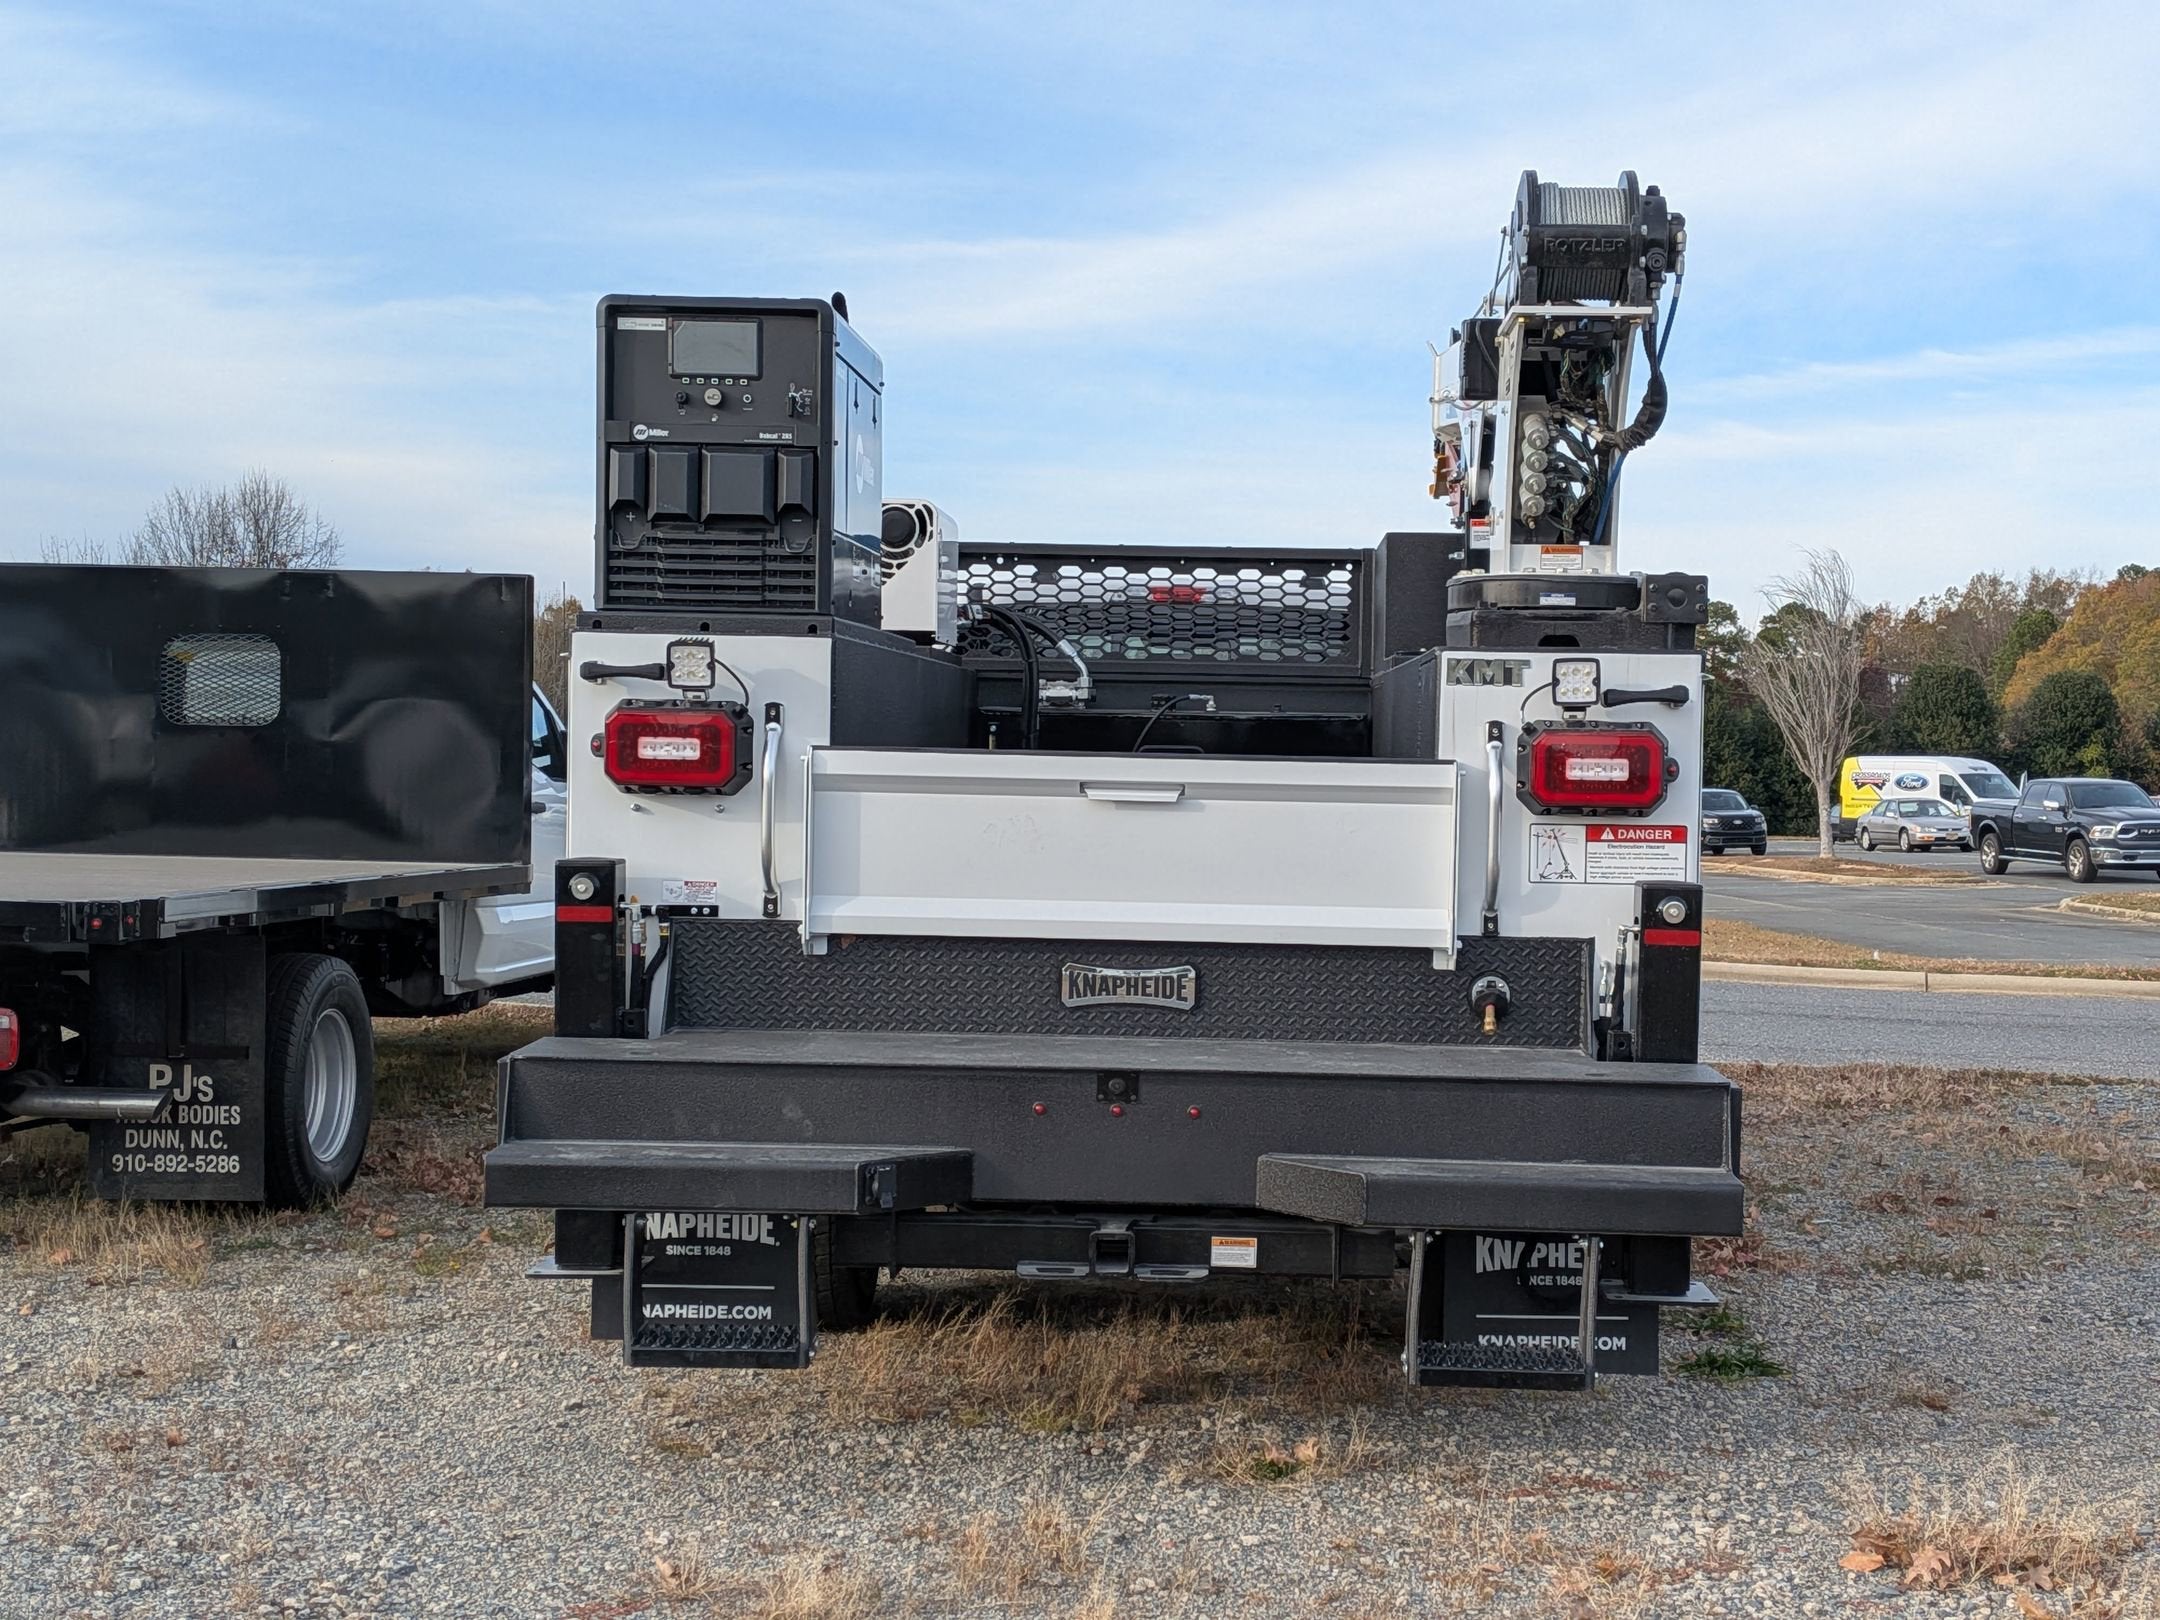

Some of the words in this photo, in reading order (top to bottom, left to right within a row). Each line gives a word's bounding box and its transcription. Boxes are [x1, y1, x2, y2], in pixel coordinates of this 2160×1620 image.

[1543, 237, 1626, 253] ROTZLER
[648, 428, 670, 437] Miller
[1446, 658, 1532, 687] KMT
[1900, 775, 1923, 788] Ford
[1617, 829, 1673, 840] DANGER
[1067, 969, 1189, 1003] KNAPHEIDE
[178, 1105, 241, 1125] BODIES
[124, 1129, 185, 1152] DUNN,
[190, 1129, 228, 1150] N.C.
[111, 1154, 240, 1174] 910-892-5286
[646, 1212, 776, 1246] NAPHEIDE
[665, 1245, 702, 1256] SINCE
[703, 1245, 732, 1256] 1848
[1556, 1275, 1583, 1286] 1848
[642, 1303, 773, 1320] NAPHEIDE.COM
